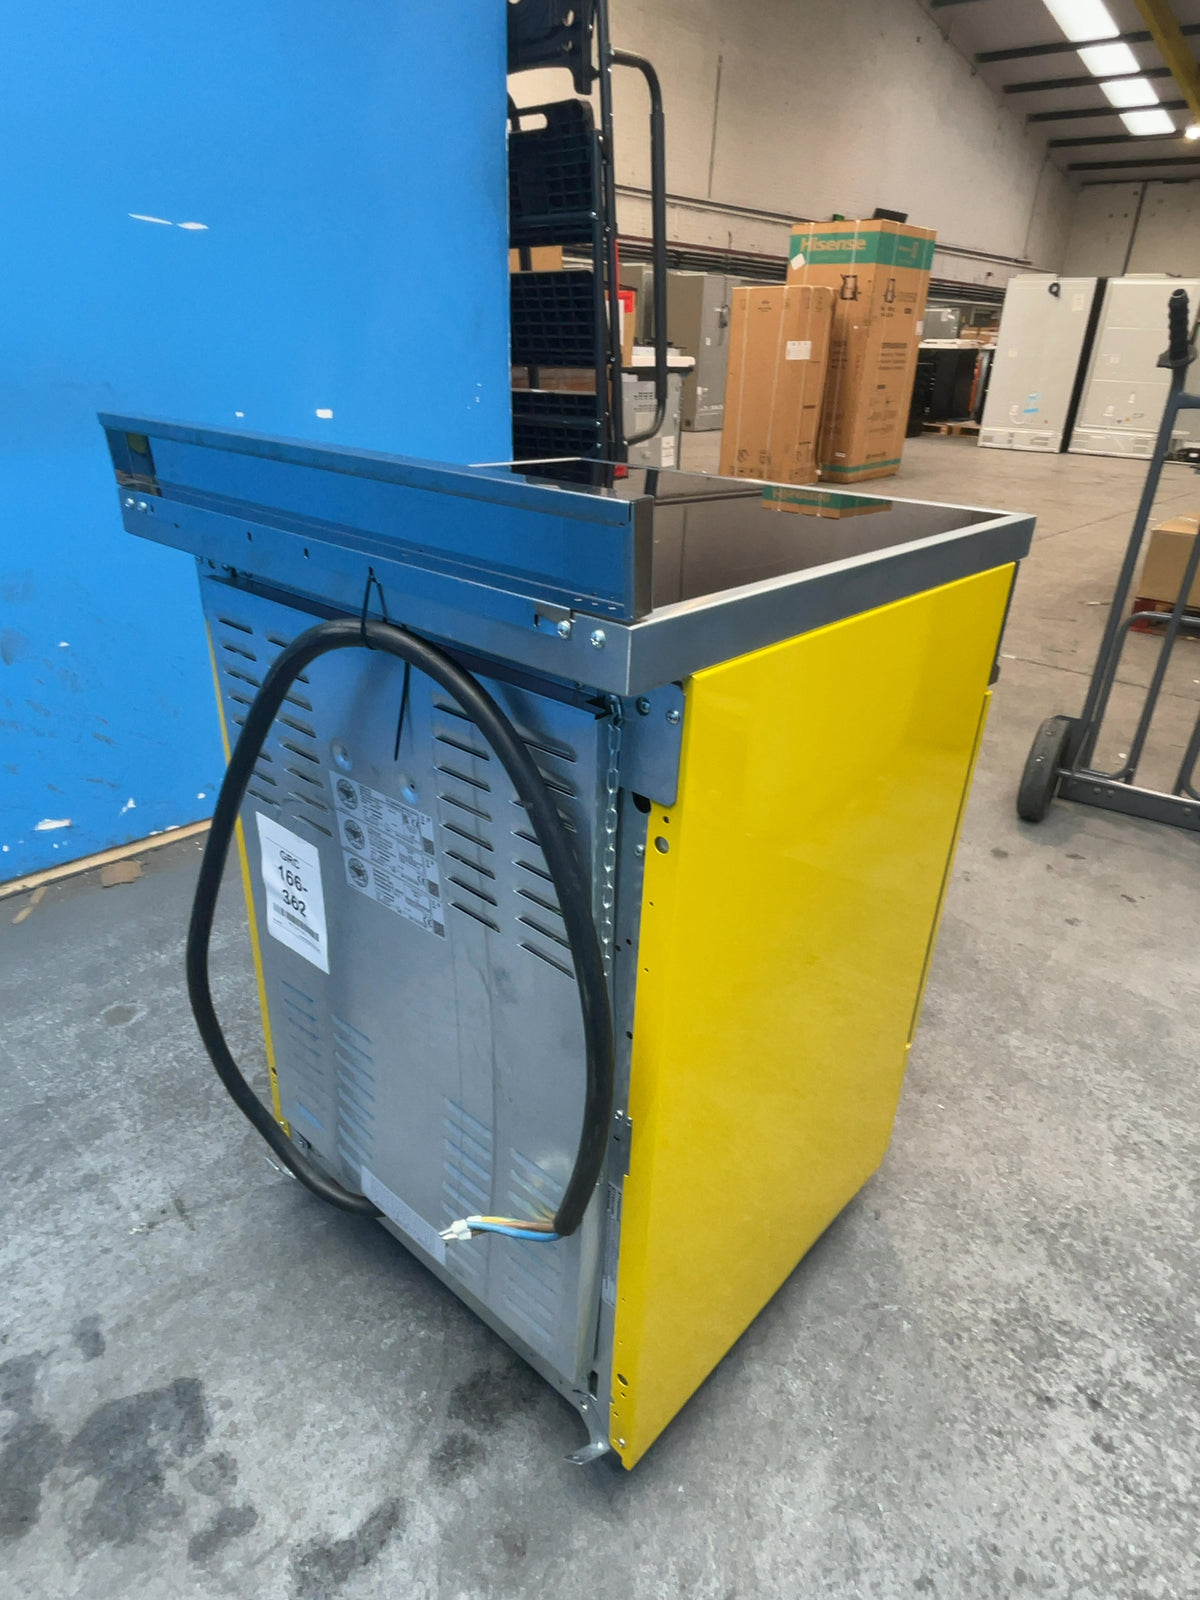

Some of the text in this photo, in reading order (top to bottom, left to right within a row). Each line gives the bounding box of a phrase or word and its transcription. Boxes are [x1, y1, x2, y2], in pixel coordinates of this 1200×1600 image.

[801, 237, 867, 251] Hisense
[278, 865, 308, 893] 166-
[282, 889, 307, 918] 362
